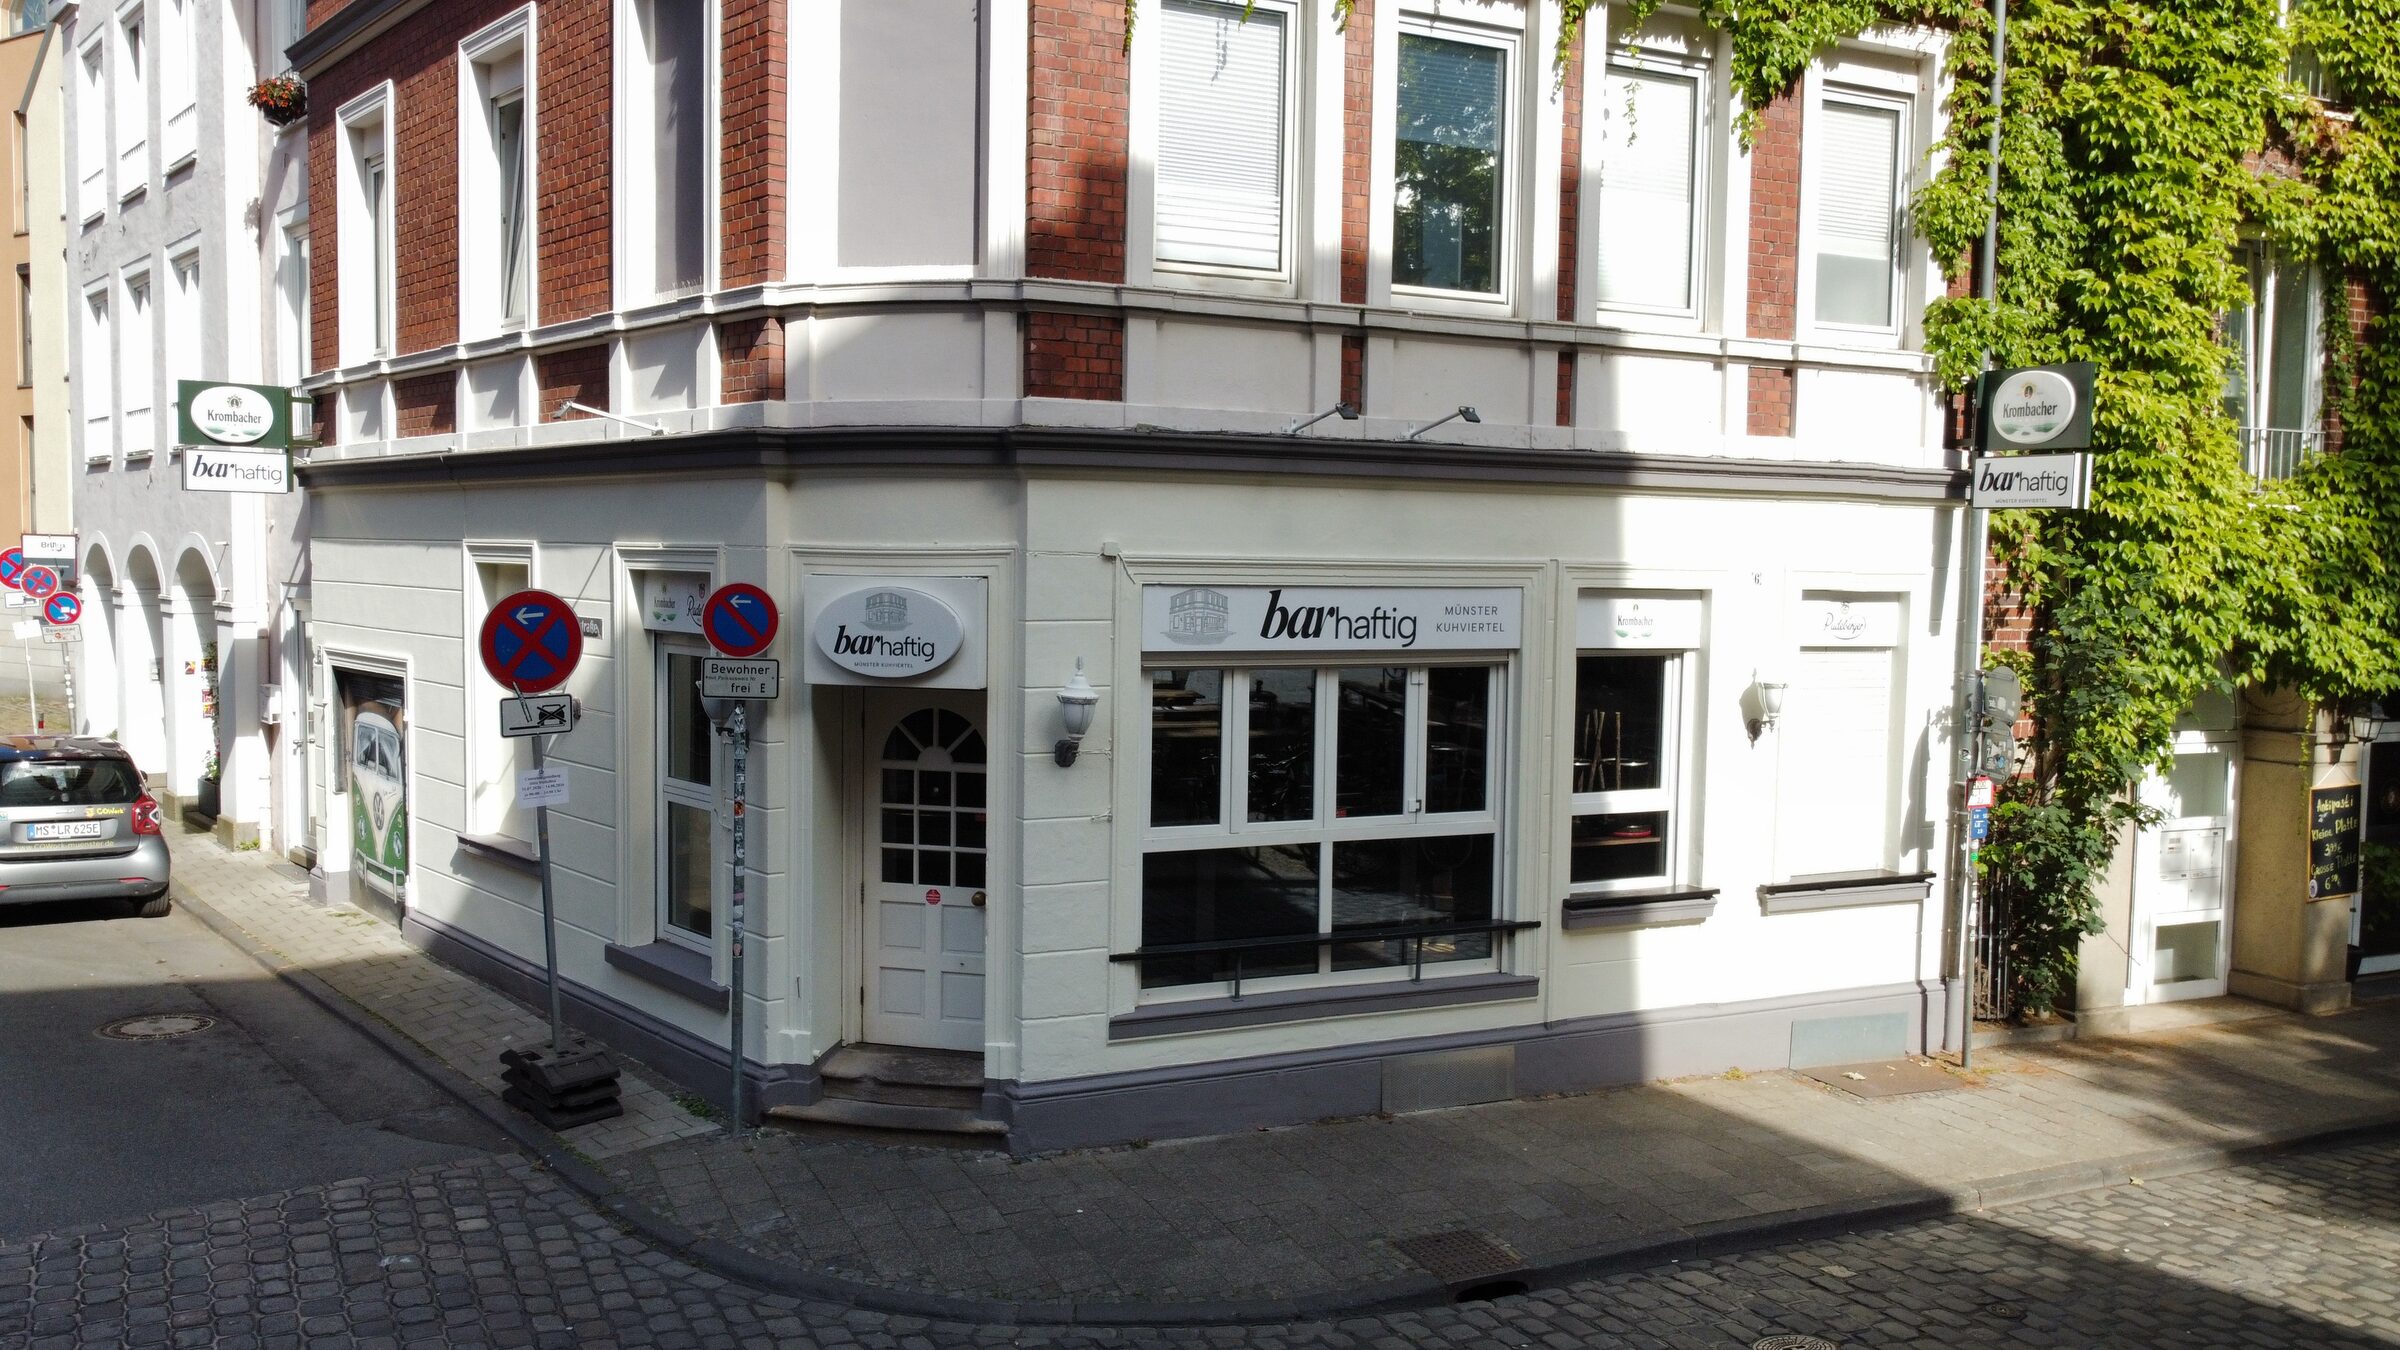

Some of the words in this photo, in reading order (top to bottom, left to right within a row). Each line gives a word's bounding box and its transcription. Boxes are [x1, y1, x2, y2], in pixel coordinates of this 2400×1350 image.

[207, 409, 262, 424] Krombacher
[2003, 401, 2058, 418] Krombacher
[192, 455, 282, 484] barhaftig
[1979, 463, 2068, 496] barhaftig
[1444, 603, 1498, 616] MÜNSTER
[1260, 589, 1417, 648] barhaftig
[1617, 615, 1654, 626] Krombacher
[1436, 622, 1505, 633] KUHVIERTEL
[834, 625, 935, 662] barhaftig
[711, 663, 770, 675] Bewohner
[731, 683, 751, 693] frei
[760, 683, 766, 693] E
[2316, 793, 2354, 814] Antipasti
[36, 824, 49, 836] MS
[57, 824, 71, 835] LR
[74, 823, 99, 834] 625E
[2311, 829, 2333, 842] Kleine
